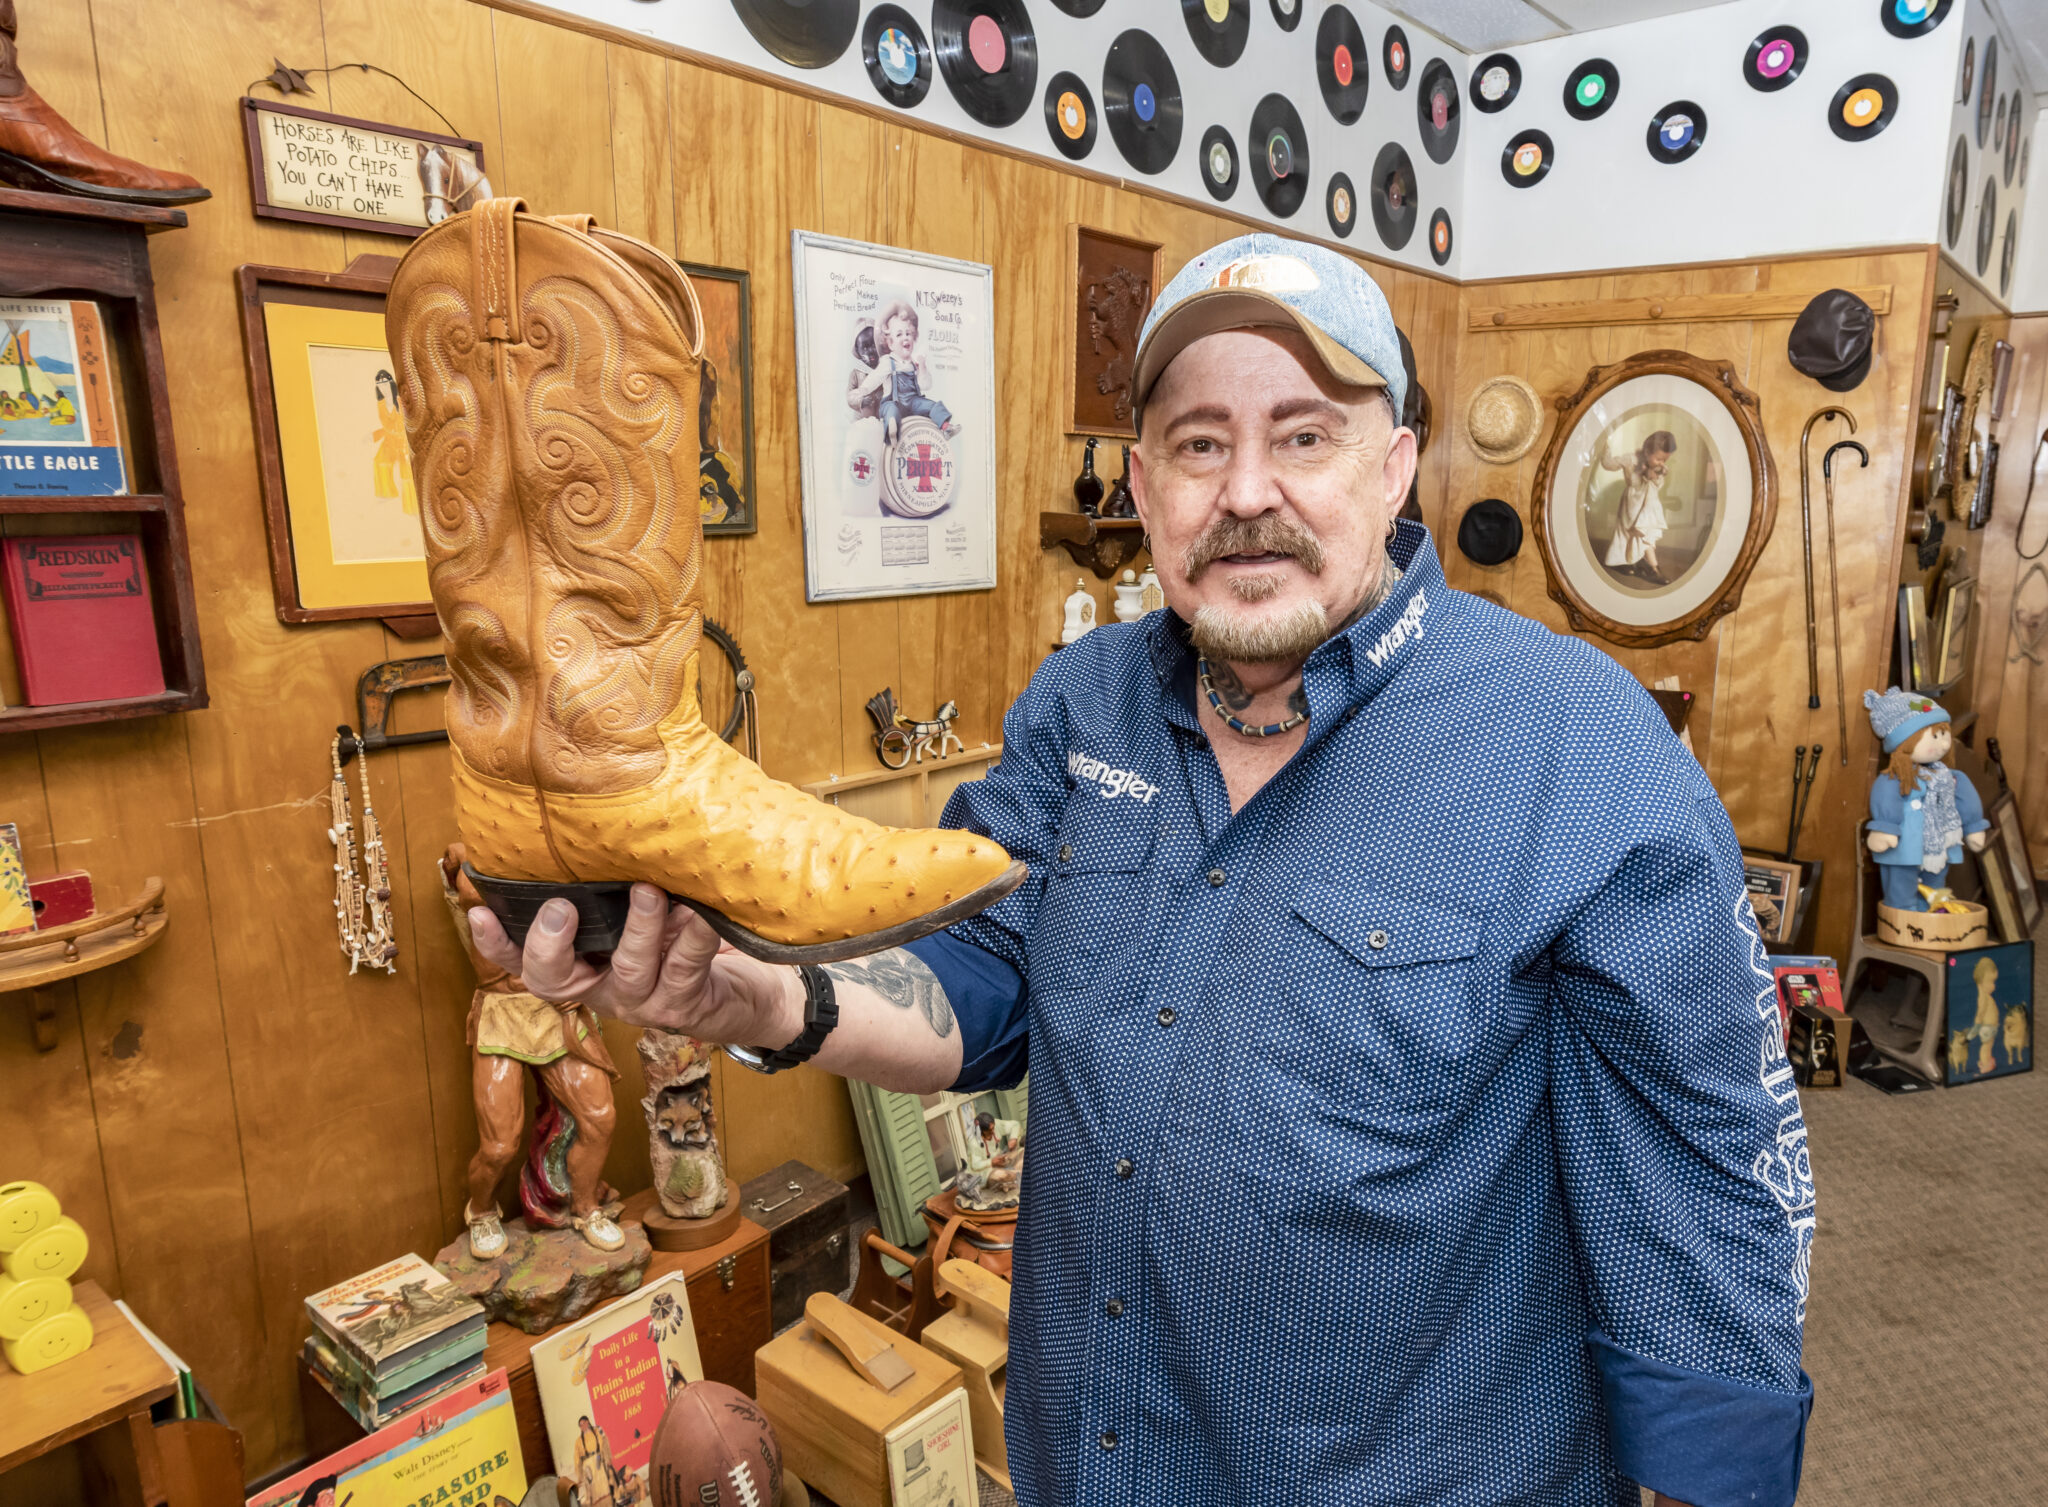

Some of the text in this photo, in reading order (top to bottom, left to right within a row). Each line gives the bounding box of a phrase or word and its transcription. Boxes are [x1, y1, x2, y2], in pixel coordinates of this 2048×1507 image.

[273, 117, 413, 160] HORSES ARE LIKE
[286, 143, 337, 167] POTATO
[277, 161, 404, 199] YOU CAN'T HAVE
[305, 190, 387, 215] JUST ONE
[830, 272, 845, 284] Only
[27, 305, 63, 314] SERIES
[43, 455, 100, 471] EAGLE
[896, 456, 953, 480] PERFECT
[38, 548, 120, 566] REDSKIN
[1366, 586, 1429, 668] Wrangler
[1067, 750, 1160, 803] Wrangler
[599, 1331, 639, 1360] Daily Life
[614, 1355, 631, 1369] in a
[592, 1356, 658, 1400] Plains Indian
[611, 1380, 645, 1405] Village
[393, 1443, 456, 1480] Walt Disney
